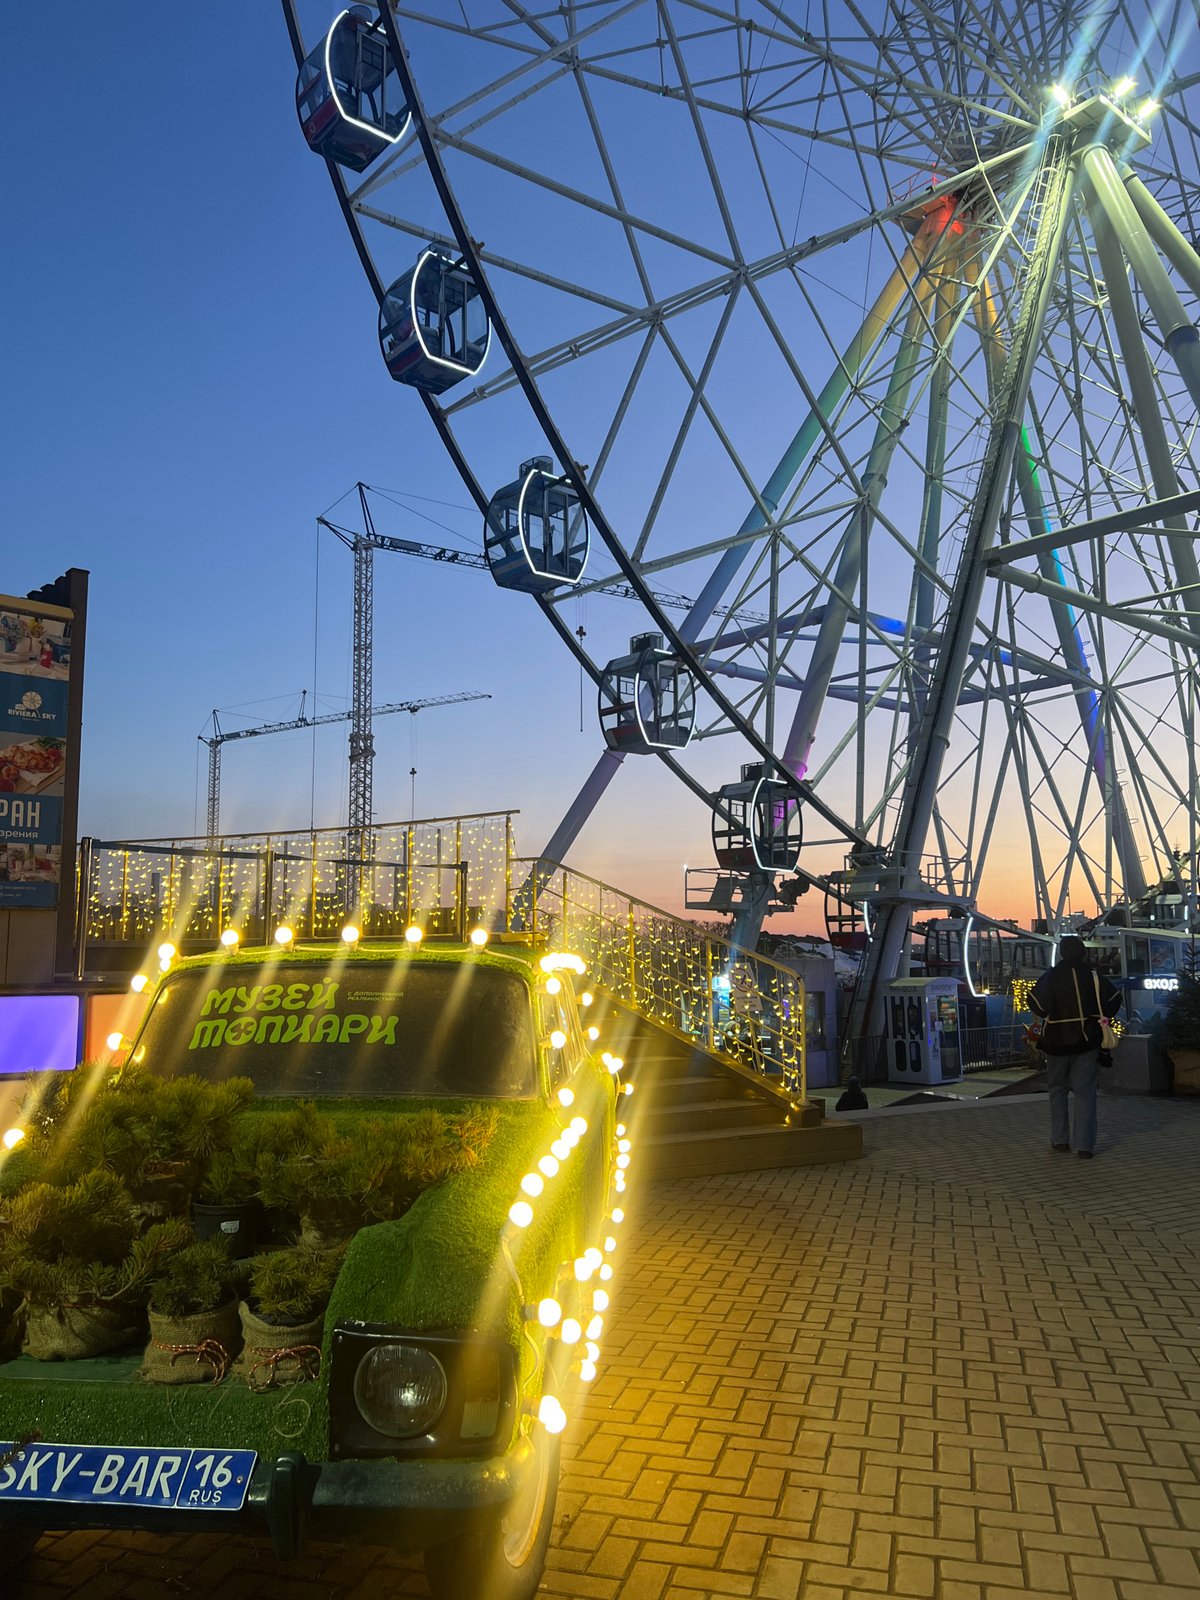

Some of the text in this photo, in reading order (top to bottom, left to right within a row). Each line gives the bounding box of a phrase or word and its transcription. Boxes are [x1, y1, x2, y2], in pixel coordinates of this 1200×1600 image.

[8, 708, 37, 718] RIVIERA
[41, 712, 57, 720] SKY
[200, 977, 339, 1016] МУЗЕЙ
[1143, 978, 1179, 991] ВХОД
[188, 1014, 399, 1049] ТОПИАРИ
[0, 1451, 182, 1498] SKY-BAR
[194, 1454, 233, 1488] 16
[189, 1489, 222, 1503] RUS
